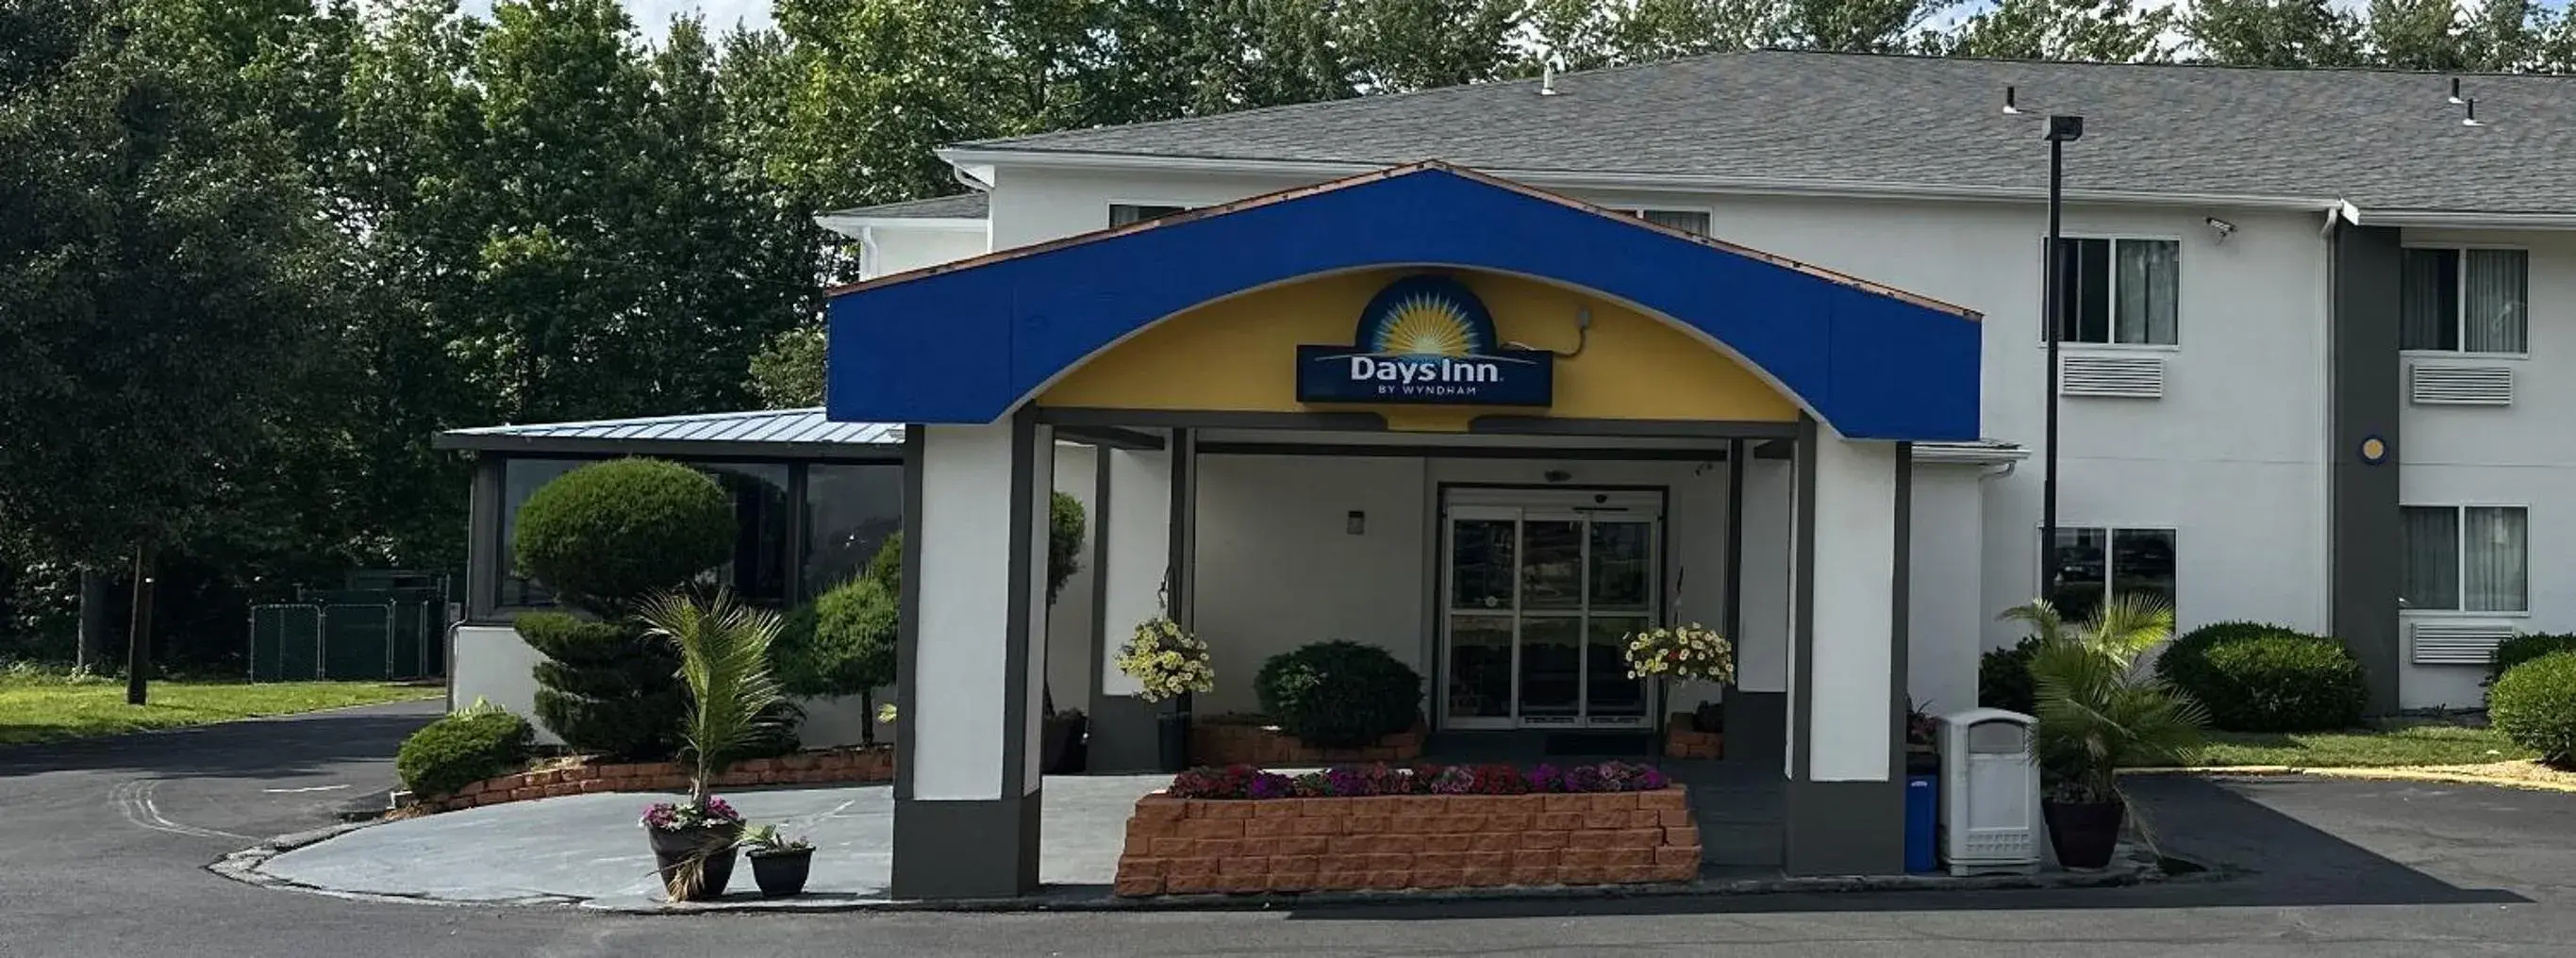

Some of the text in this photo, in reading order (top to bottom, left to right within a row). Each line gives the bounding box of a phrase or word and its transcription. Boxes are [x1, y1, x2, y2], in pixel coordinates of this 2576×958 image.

[1350, 356, 1499, 384] Days Inn
[1378, 385, 1477, 396] BY WYNDHAM
